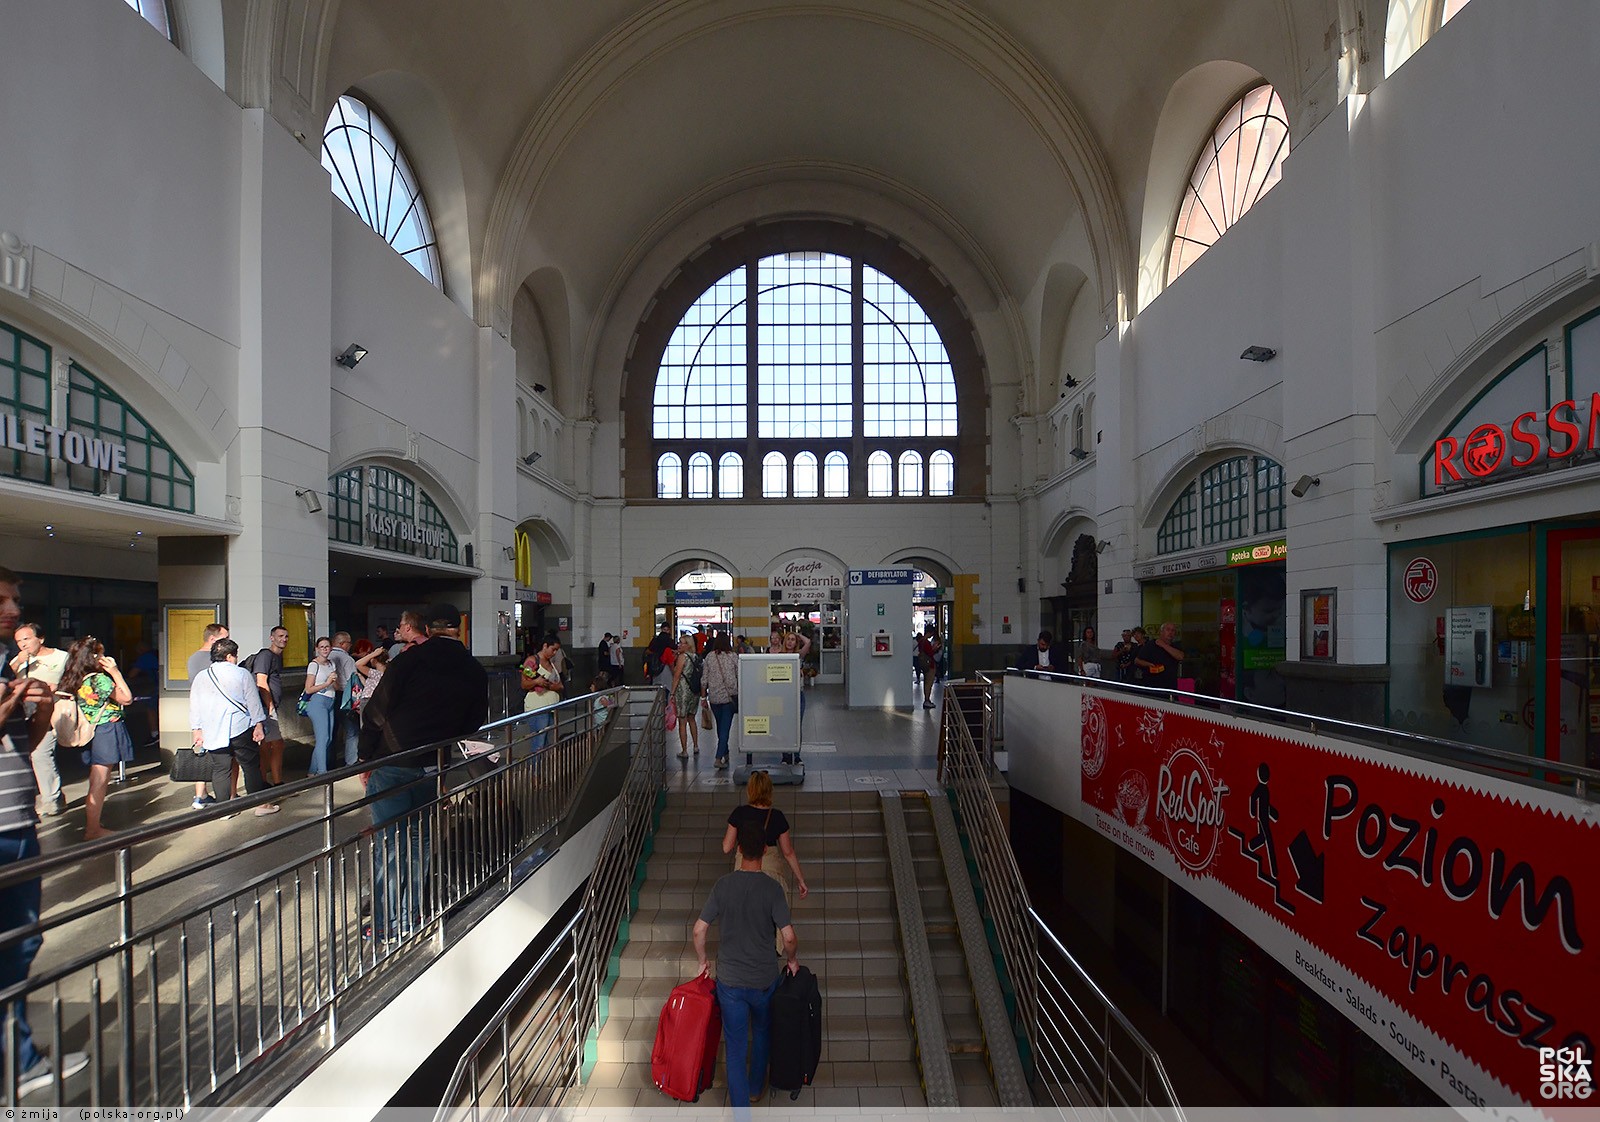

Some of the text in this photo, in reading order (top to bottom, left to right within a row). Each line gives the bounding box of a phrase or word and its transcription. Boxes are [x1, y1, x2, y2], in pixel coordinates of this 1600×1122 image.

[370, 513, 444, 548] KASY BILETOWE
[785, 561, 823, 578] Gracja
[1162, 561, 1191, 573] PIECZYWO
[1231, 550, 1250, 562] Apteka
[773, 575, 840, 587] Kwiaciarnia
[867, 570, 908, 578] DEFIBRYLATOR
[1157, 764, 1230, 834] RedSpot
[1095, 813, 1155, 860] Taste on the move
[1177, 828, 1200, 856] Cafe
[1323, 775, 1584, 954] Poziom
[1294, 949, 1336, 993] Breakfast
[1346, 988, 1377, 1025] Salads
[1389, 1022, 1426, 1064] Soups
[1440, 1060, 1487, 1113] Pastas
